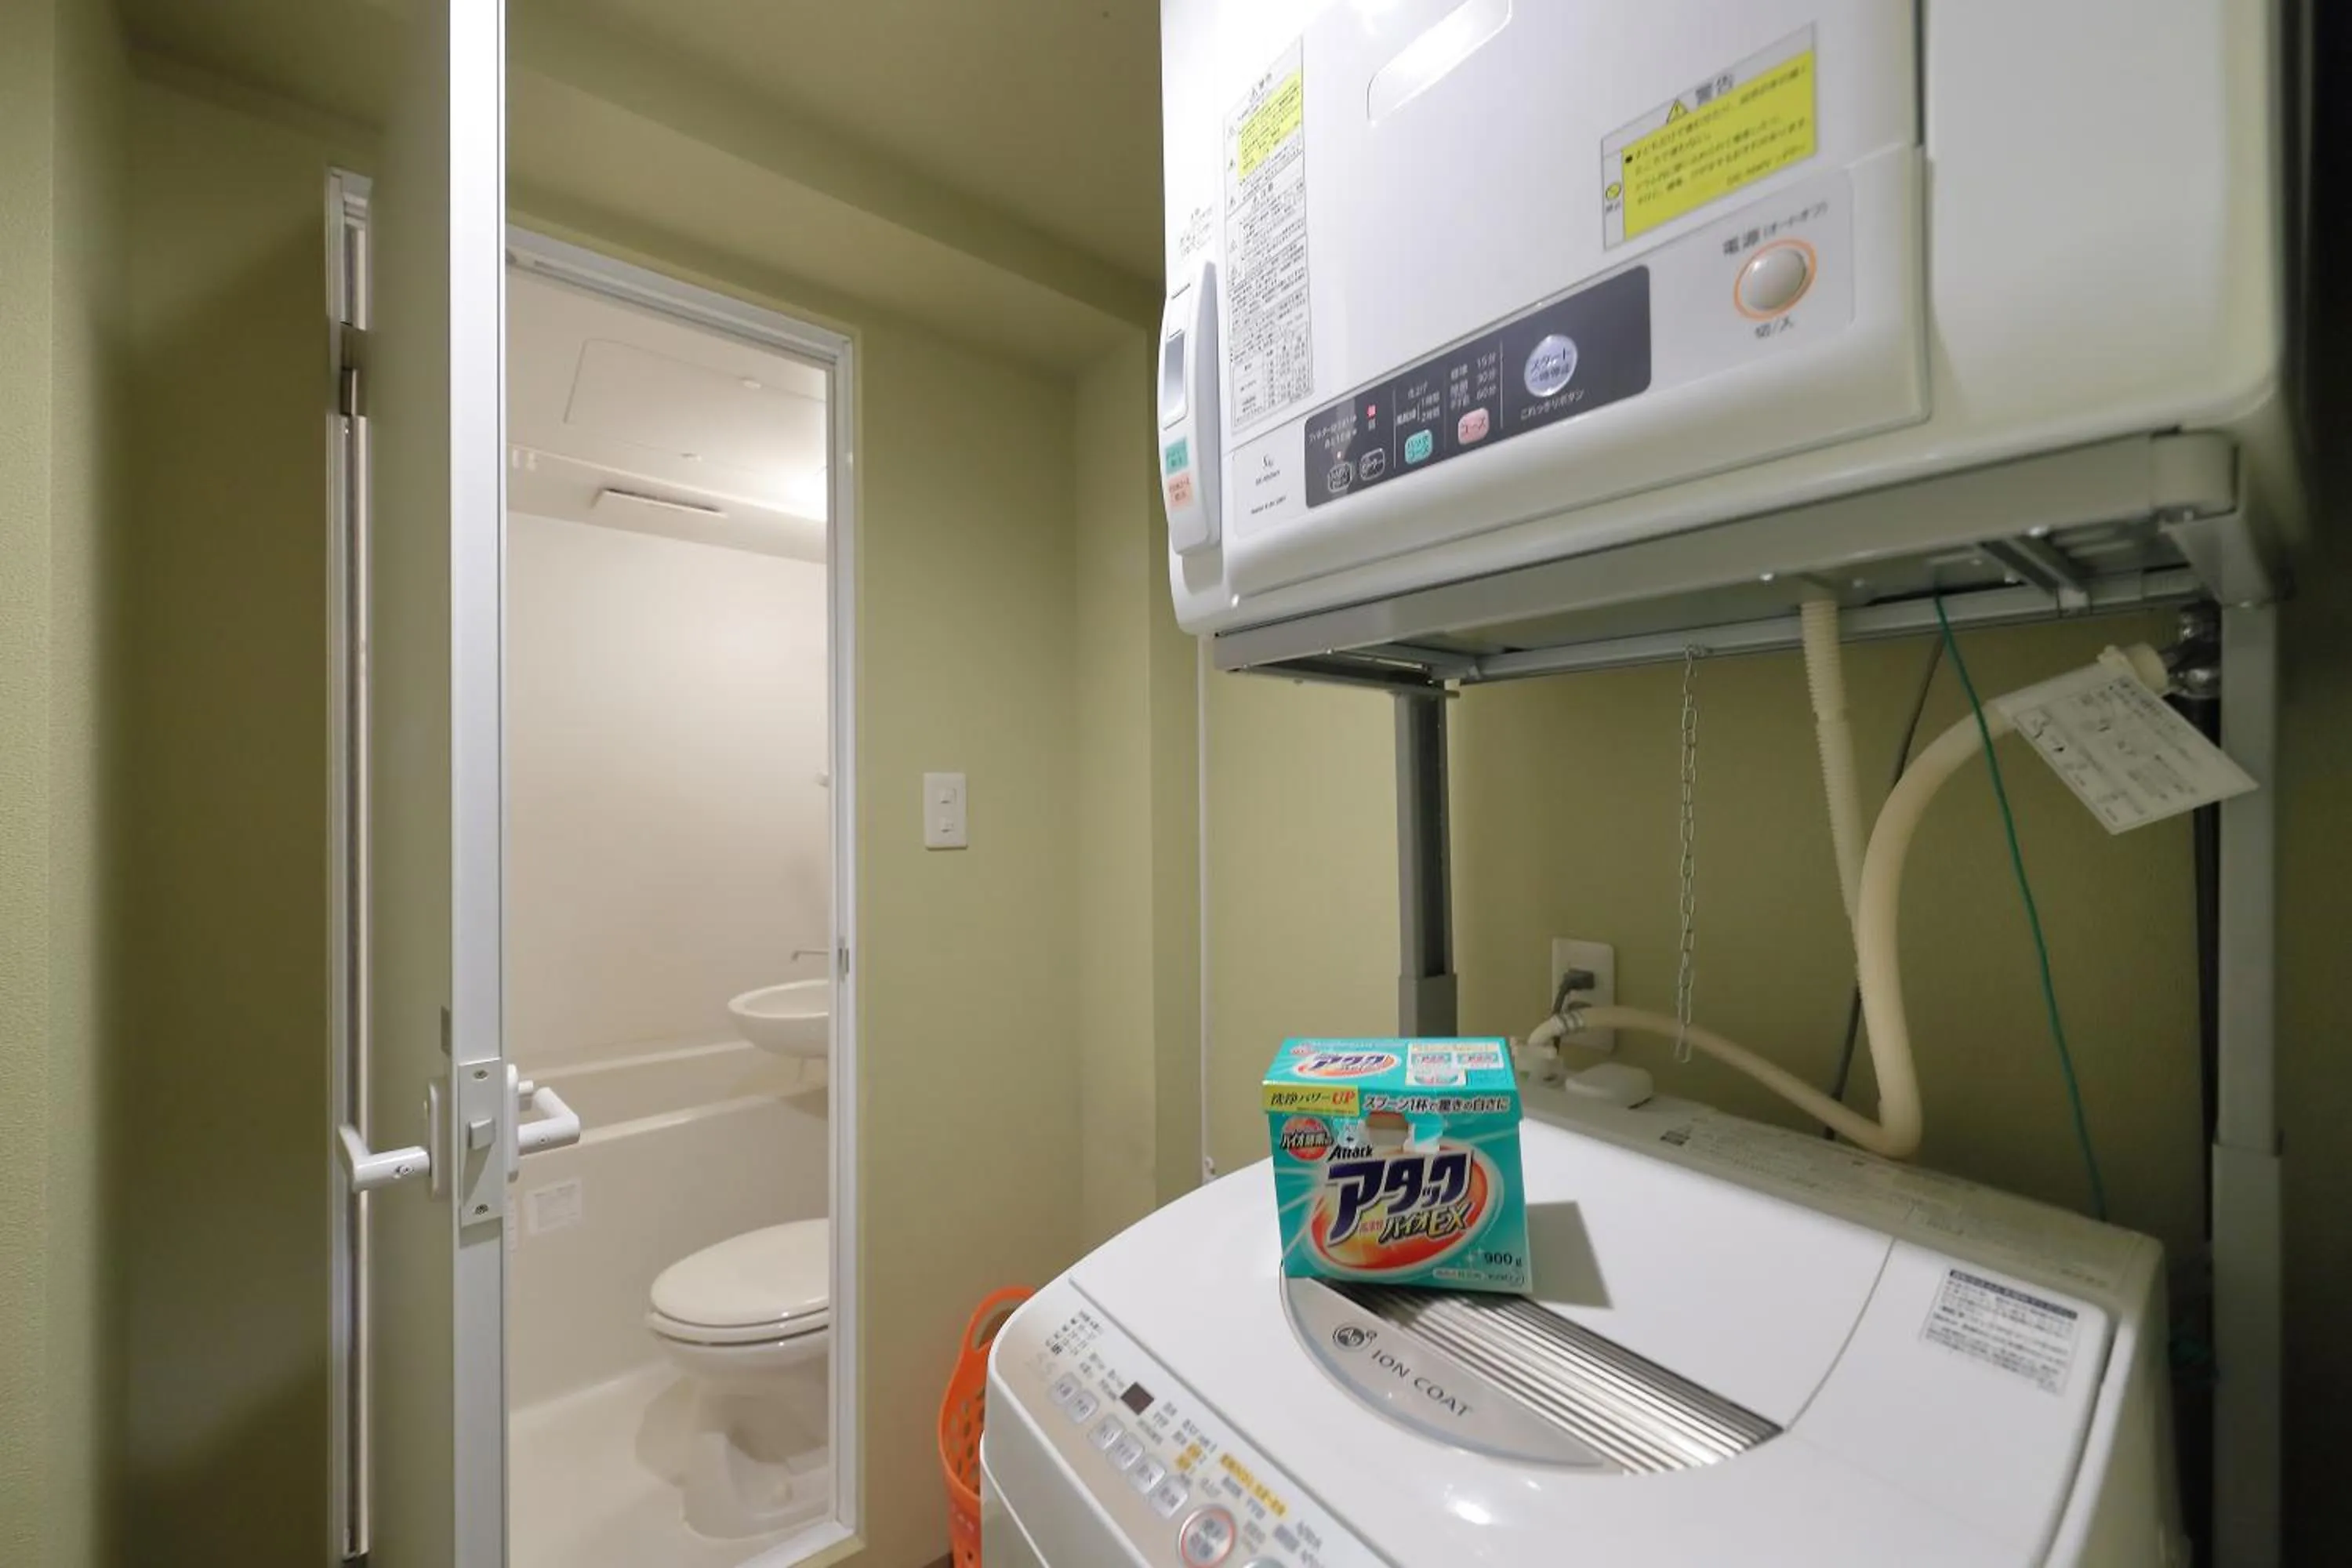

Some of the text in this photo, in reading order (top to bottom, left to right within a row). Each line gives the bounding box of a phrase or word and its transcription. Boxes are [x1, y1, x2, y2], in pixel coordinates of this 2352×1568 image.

[1327, 1152, 1471, 1243] アタック
[1371, 1348, 1473, 1417] ION COAT
